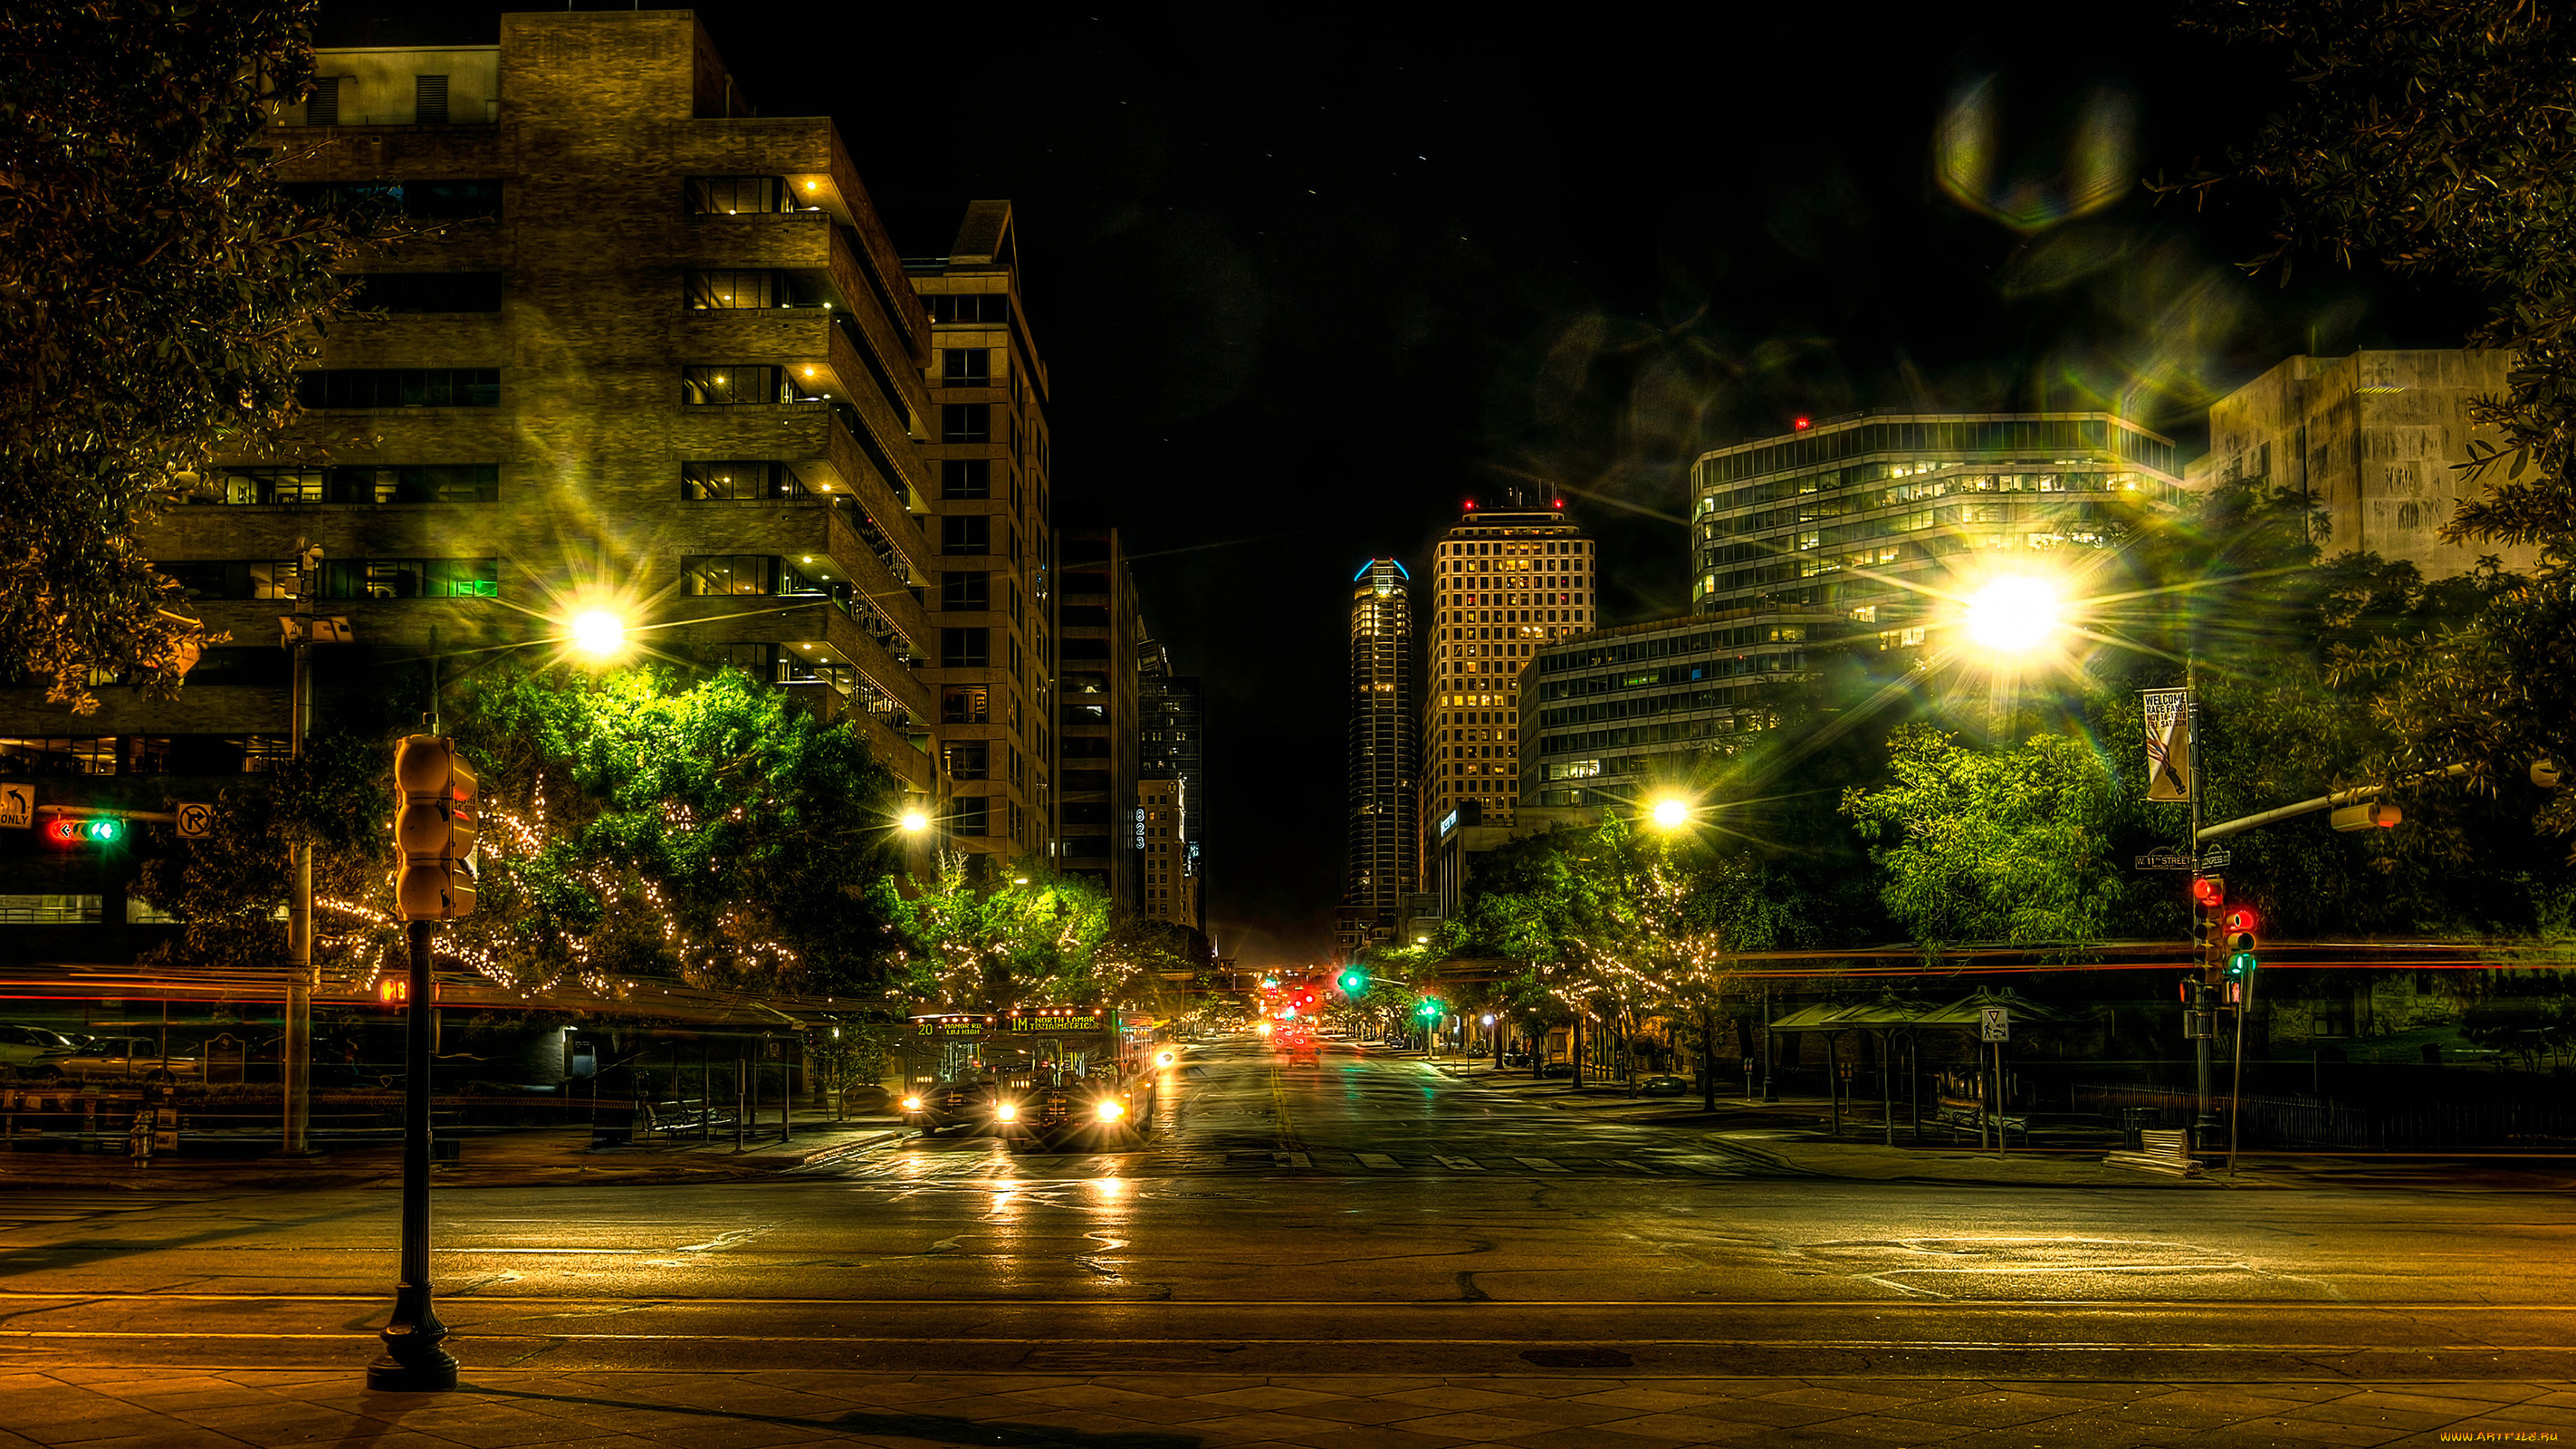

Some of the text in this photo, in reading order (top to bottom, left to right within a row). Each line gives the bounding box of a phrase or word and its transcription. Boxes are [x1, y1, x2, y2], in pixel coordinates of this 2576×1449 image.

[2145, 694, 2186, 705] WELCOME
[2147, 704, 2187, 714] RACE FANS!
[2148, 719, 2187, 729] FRI SAT SUN
[1, 814, 28, 825] ONLY
[1135, 808, 1145, 849] 823
[2161, 857, 2190, 865] STREET
[918, 1023, 933, 1036] 20
[1011, 1017, 1028, 1031] 1M
